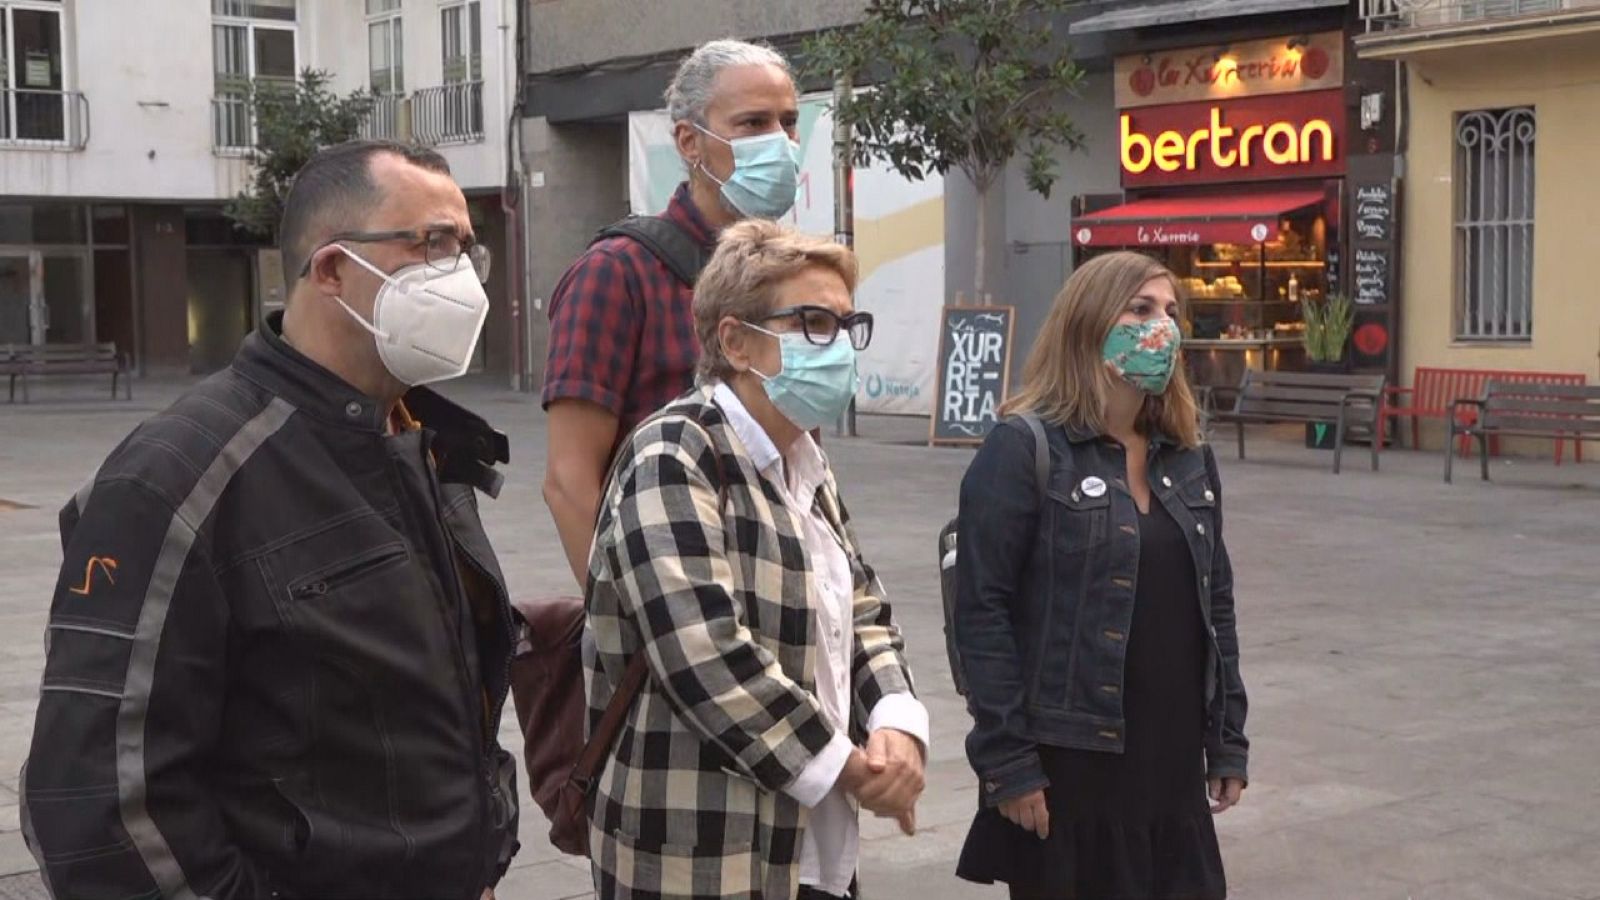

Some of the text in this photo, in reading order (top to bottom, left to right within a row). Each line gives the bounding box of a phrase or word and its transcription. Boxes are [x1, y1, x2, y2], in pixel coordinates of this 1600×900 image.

[1120, 107, 1332, 173] bertran
[949, 331, 1003, 364] XUR
[945, 361, 999, 391] RE-
[943, 390, 998, 422] RIA
